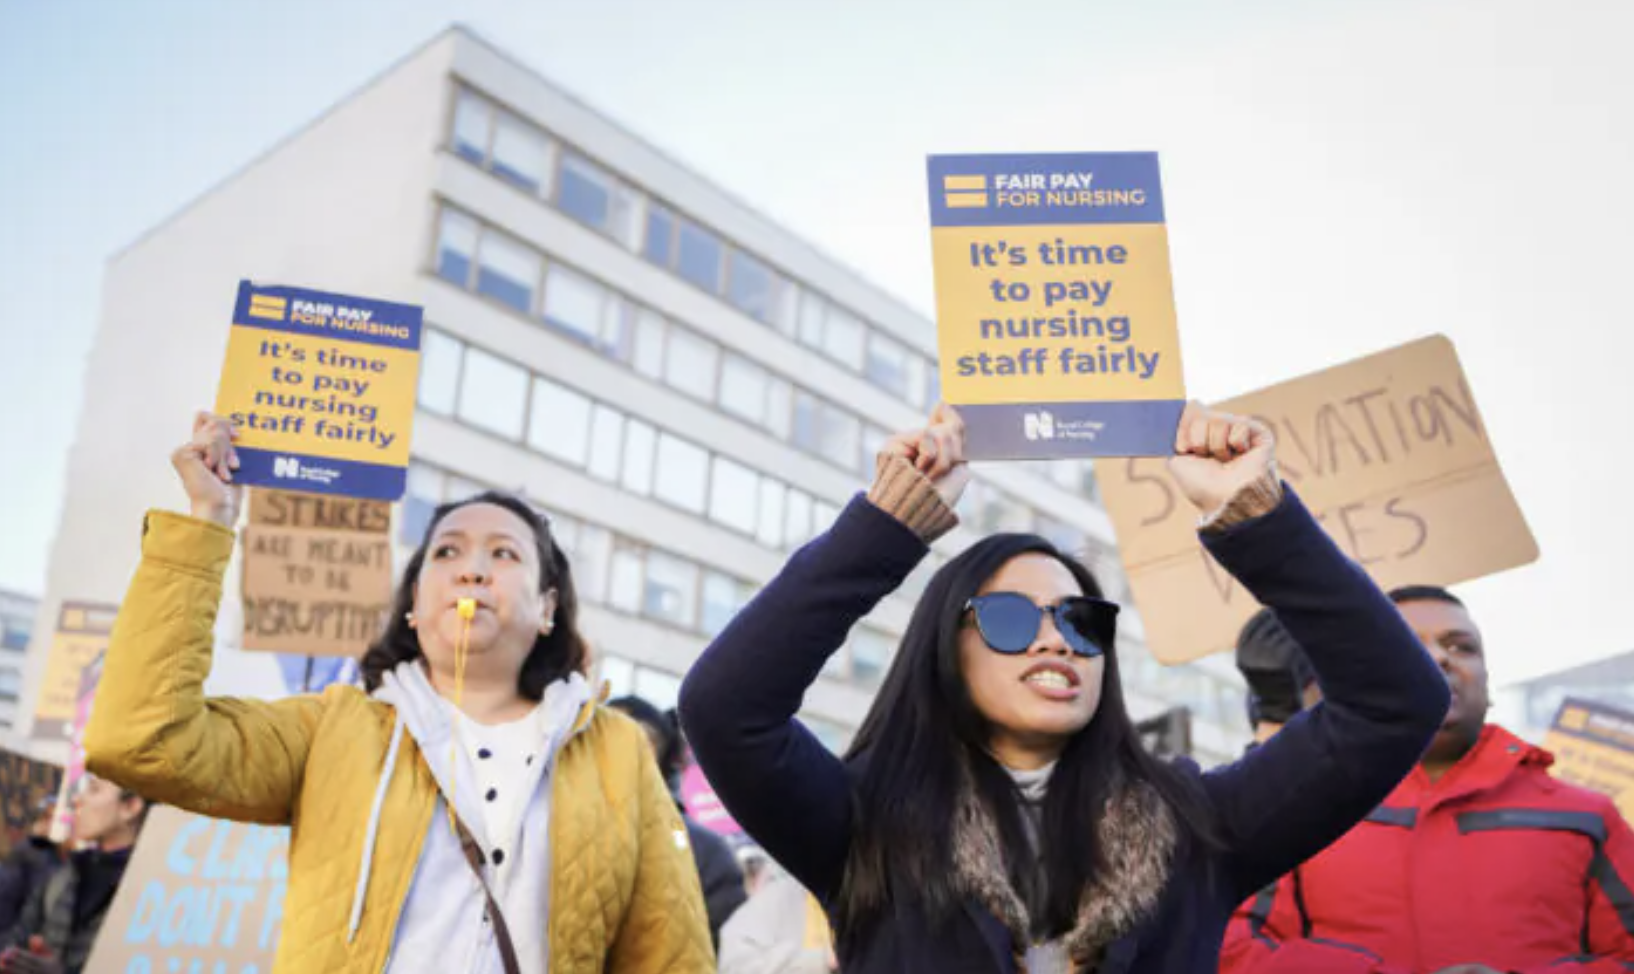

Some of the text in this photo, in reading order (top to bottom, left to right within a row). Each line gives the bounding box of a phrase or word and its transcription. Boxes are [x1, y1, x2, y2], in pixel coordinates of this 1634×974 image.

[995, 172, 1093, 190] FAIR PAY
[996, 189, 1146, 208] FOR NURSING
[969, 238, 1128, 267] It’s time
[990, 278, 1113, 307] to pay
[292, 299, 373, 321] FAIR PAY
[291, 312, 410, 339] FOR NURSING
[980, 309, 1131, 343] nursing
[260, 341, 387, 372] It’s time
[956, 346, 1159, 379] staff fairly
[272, 367, 369, 397] to pay
[255, 391, 378, 423] nursing
[230, 412, 395, 449] staff fairly
[261, 491, 390, 532] STRIKES
[255, 536, 388, 569] ARE MEANT
[284, 566, 352, 592] TO BE
